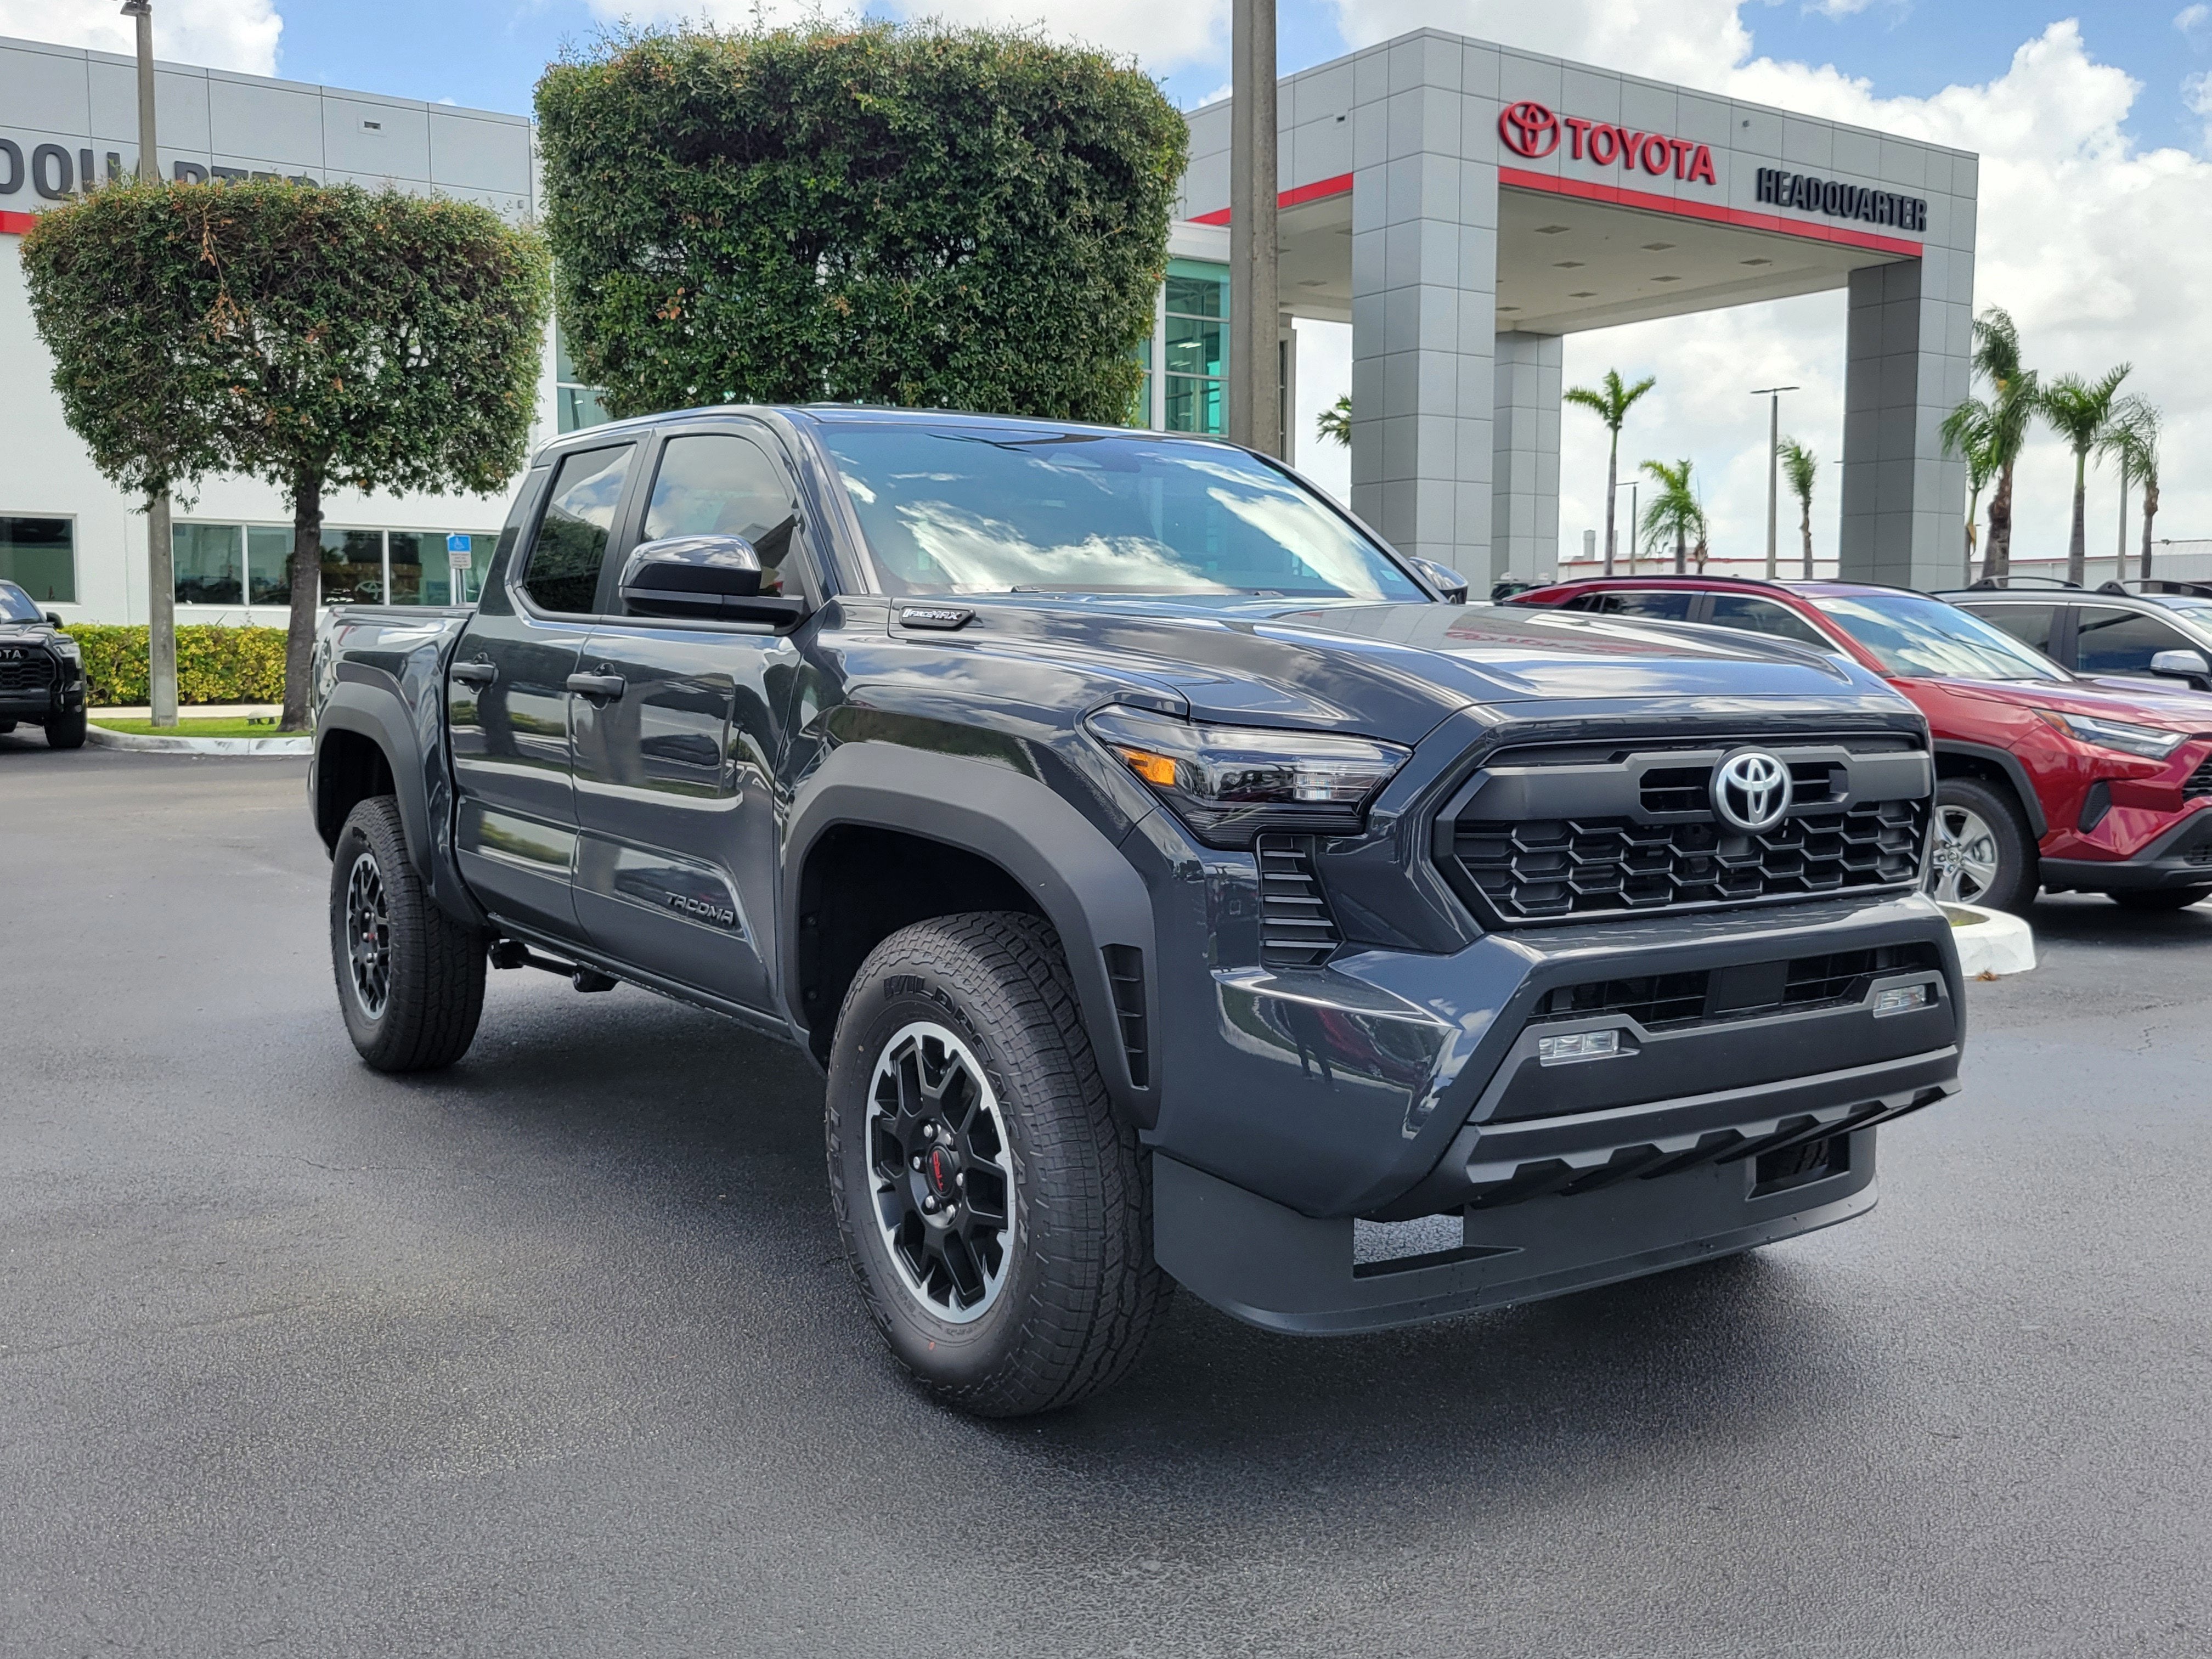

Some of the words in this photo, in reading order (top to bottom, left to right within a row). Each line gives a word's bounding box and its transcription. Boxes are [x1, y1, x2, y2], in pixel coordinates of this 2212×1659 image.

[1565, 117, 1717, 185] TOYOTA
[1756, 167, 1927, 232] HEADQUARTER
[0, 650, 22, 659] TA
[665, 891, 734, 925] TACOMA
[884, 973, 1021, 1140] WILDPEAK
